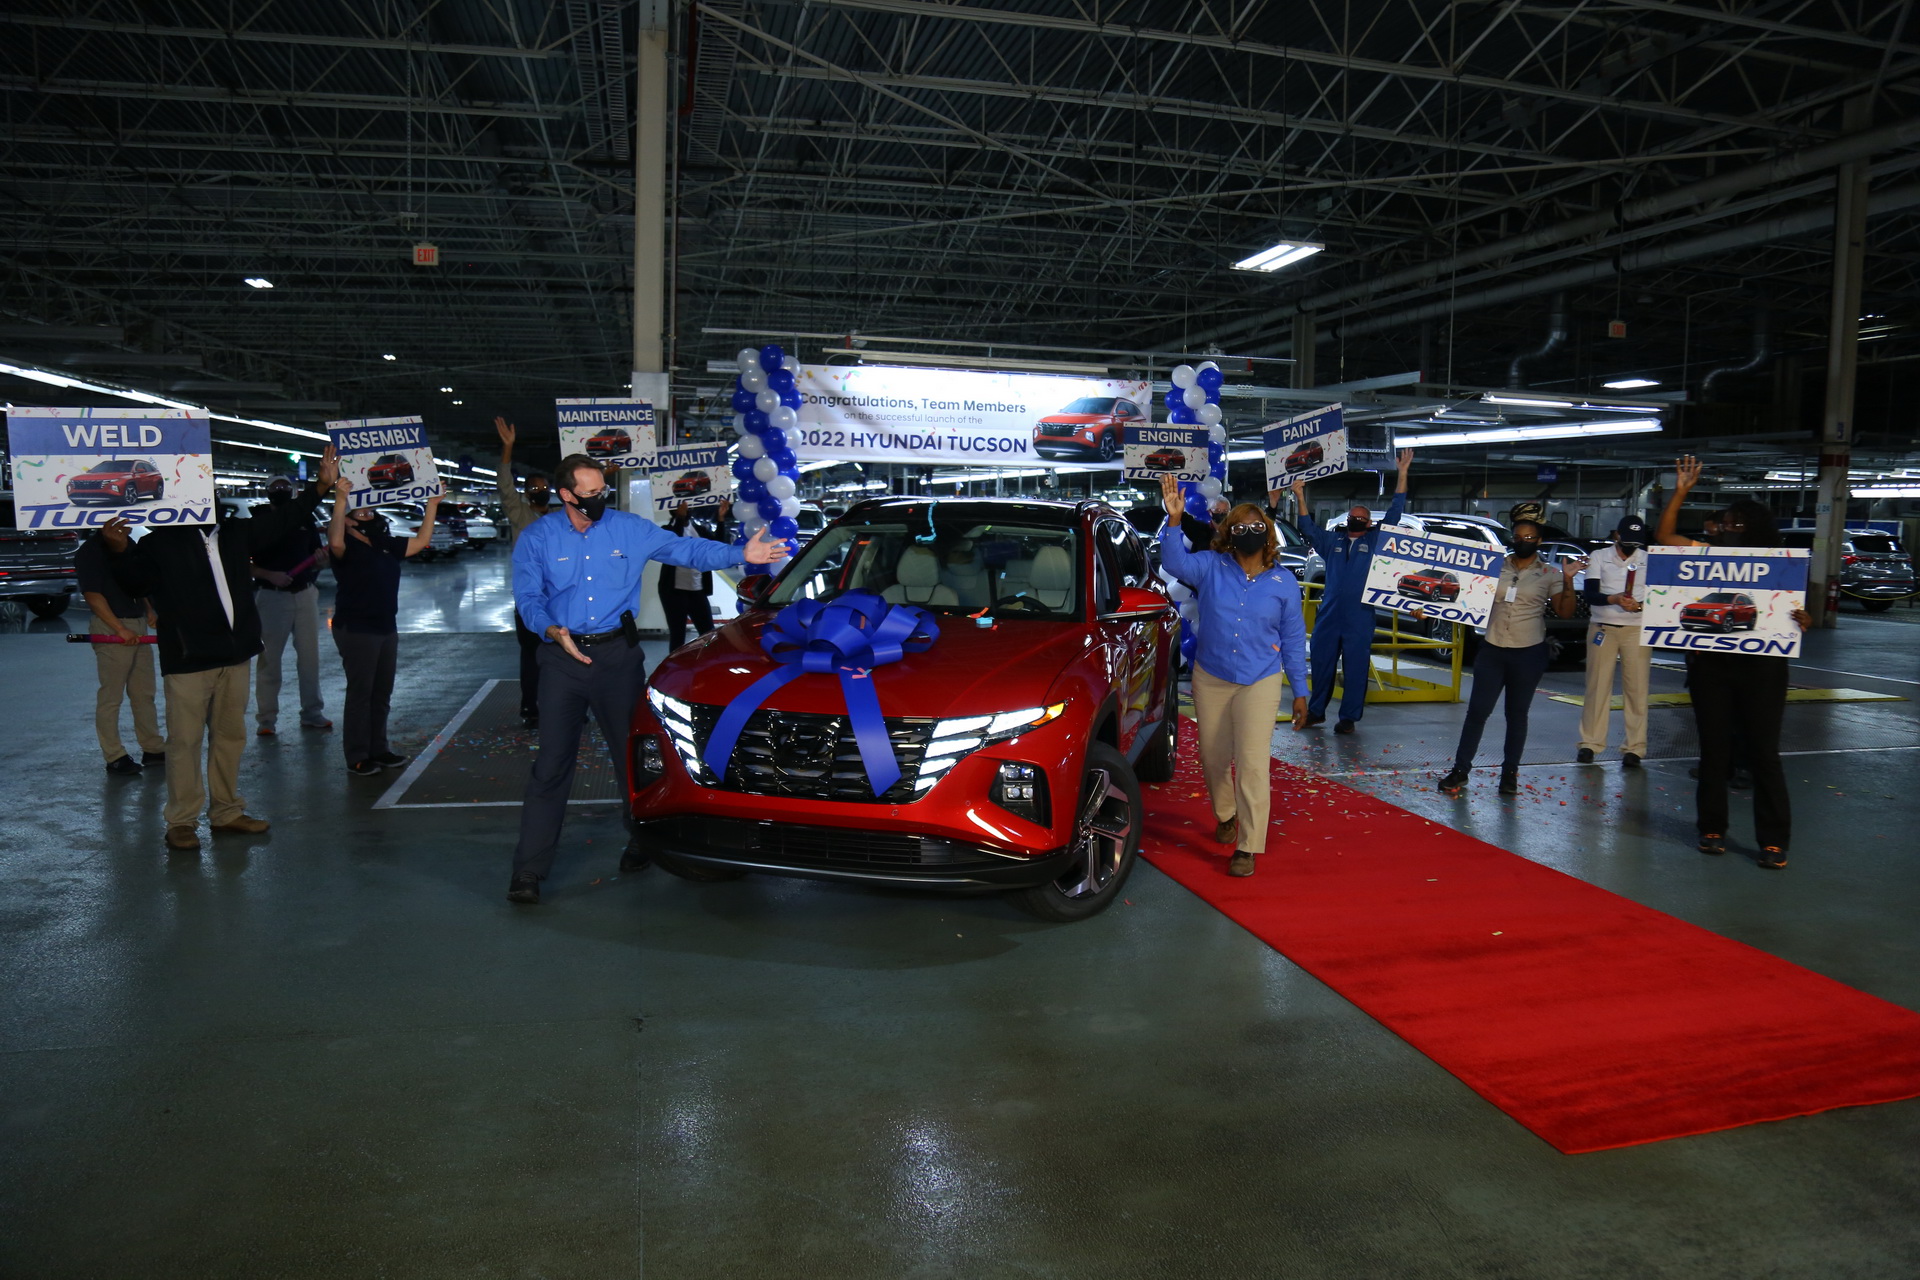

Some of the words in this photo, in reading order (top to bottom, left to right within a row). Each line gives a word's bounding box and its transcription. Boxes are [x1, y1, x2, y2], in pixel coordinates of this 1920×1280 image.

[417, 248, 435, 262] EXIT
[801, 392, 918, 411] Congratulations,
[921, 398, 960, 411] Team
[963, 400, 1026, 413] Members
[558, 408, 653, 423] MAINTENANCE
[858, 411, 874, 420] the
[875, 412, 923, 422] successful
[925, 414, 955, 423] launch
[957, 415, 967, 424] of
[968, 416, 983, 425] the
[62, 424, 163, 448] WELD
[338, 427, 420, 451] ASSEMBLY
[800, 429, 846, 447] 2022
[850, 432, 942, 450] HYUNDAI
[947, 435, 1027, 453] TUCSON
[1138, 430, 1193, 444] ENGINE
[1282, 418, 1322, 443] PAINT
[659, 450, 718, 470] QUALITY
[1382, 536, 1497, 571] ASSEMBLY
[1677, 560, 1771, 584] STAMP
[1644, 626, 1797, 655] TUCSON
